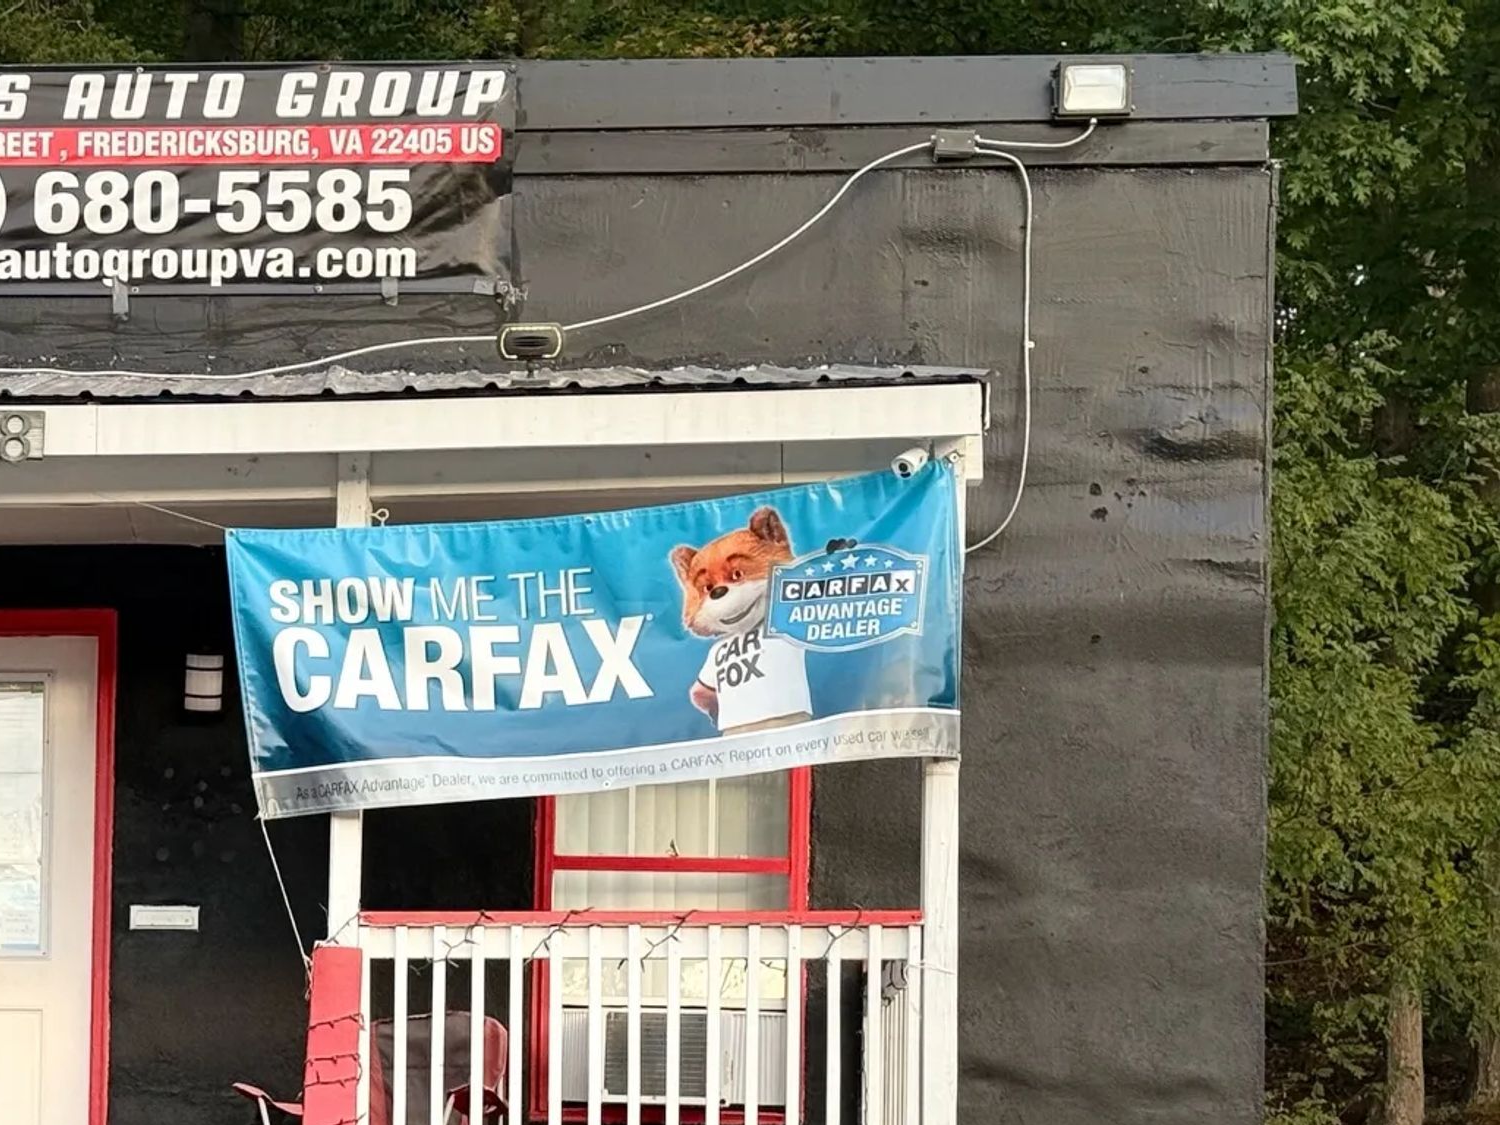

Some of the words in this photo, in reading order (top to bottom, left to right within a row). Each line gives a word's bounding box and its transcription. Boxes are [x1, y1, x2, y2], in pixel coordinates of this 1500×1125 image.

[62, 72, 245, 121] AUTO
[275, 70, 507, 118] GROUP
[77, 128, 319, 159] FREDERICKSBURG,
[330, 128, 364, 154] VA
[371, 128, 452, 154] 22405
[461, 127, 496, 154] US
[33, 169, 413, 234] 680-5585
[269, 577, 414, 625] SHOW
[429, 578, 498, 622] ME
[512, 567, 595, 619] THE
[781, 571, 915, 601] CARFAX
[788, 599, 902, 623] ADVANTAGE
[806, 619, 881, 641] DEALER
[272, 614, 655, 714] CARFAX
[714, 628, 761, 667] CAR
[715, 654, 765, 693] FOX
[318, 781, 358, 797] CARFAX
[361, 776, 426, 793] Advantage
[432, 773, 475, 788] Dealer,
[479, 775, 496, 785] we
[500, 772, 520, 785] are
[523, 766, 588, 784] committed
[591, 767, 604, 778] to
[607, 763, 655, 778] offering
[659, 762, 668, 772] a
[671, 753, 722, 770] CARFAX
[729, 745, 772, 763] Report
[775, 745, 792, 756] on
[796, 737, 830, 754] every
[833, 730, 864, 745] used
[868, 731, 887, 742] car
